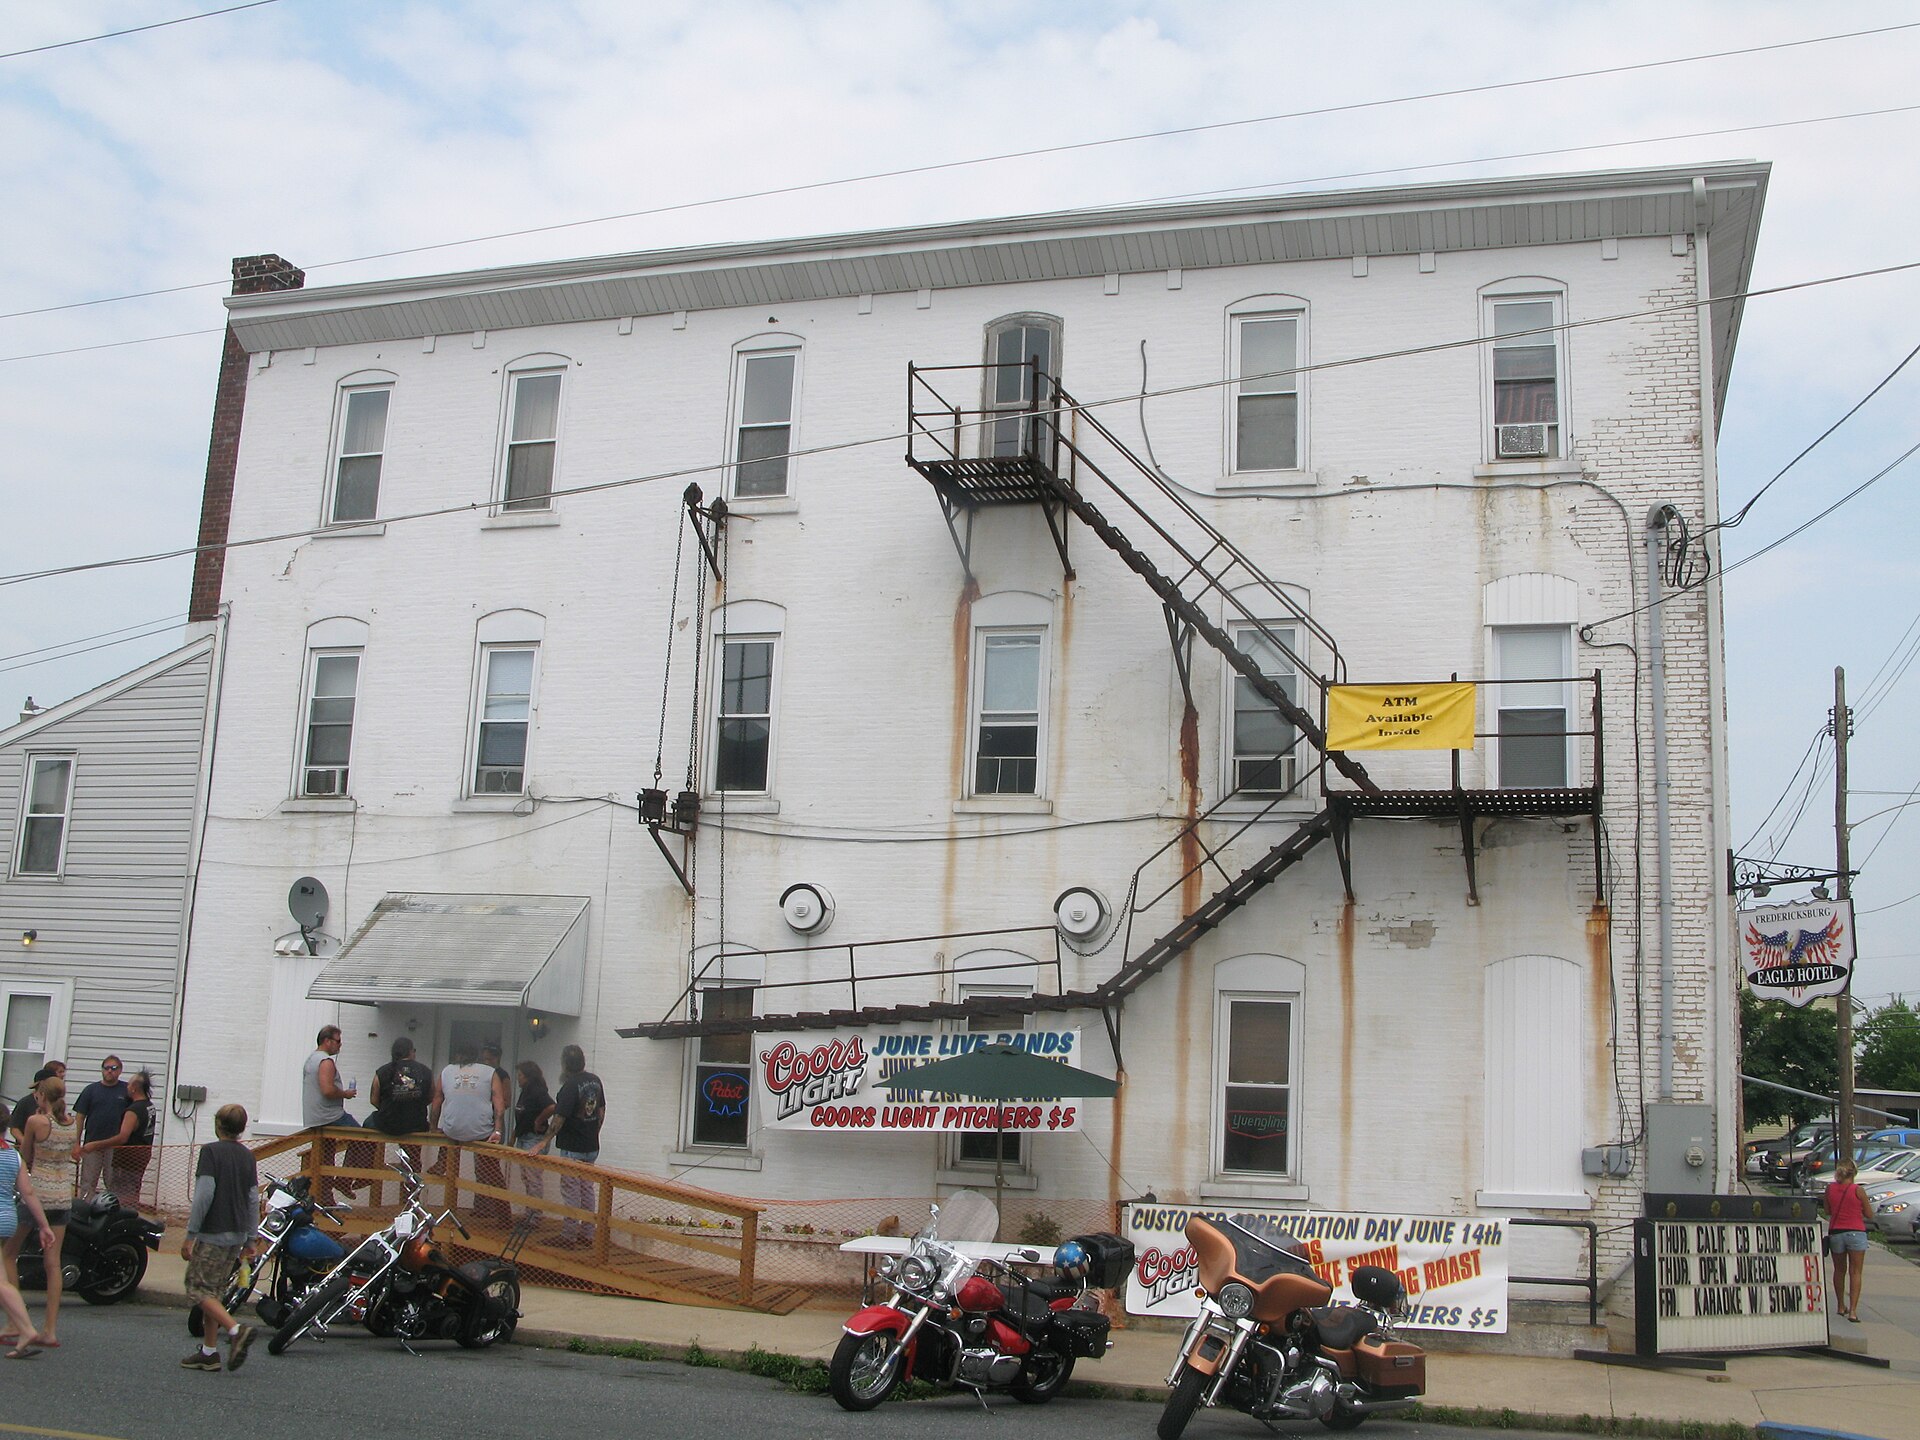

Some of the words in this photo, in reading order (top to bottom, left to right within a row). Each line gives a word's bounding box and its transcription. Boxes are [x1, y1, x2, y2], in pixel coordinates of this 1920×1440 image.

[1382, 697, 1418, 707] ATM
[1365, 713, 1433, 723] Available
[1378, 728, 1420, 737] Inside
[1755, 907, 1831, 924] FREDERICKSBURG
[1757, 970, 1795, 985] EAGLE
[1797, 965, 1838, 982] HOTEL
[871, 1035, 933, 1056] JUNE
[939, 1034, 989, 1055] LIVE
[760, 1035, 868, 1095] Coors
[709, 1079, 744, 1100] Pabst
[777, 1067, 867, 1121] LIGHT
[811, 1106, 876, 1127] COORS
[881, 1106, 940, 1128] LIGHT
[942, 1106, 1043, 1129] PITCHERS
[1047, 1106, 1076, 1130] $5
[1231, 1114, 1287, 1132] Yuengling
[1131, 1208, 1227, 1232] CUSTO
[1364, 1217, 1403, 1242] DAY
[1404, 1219, 1455, 1244] JUNE
[1462, 1222, 1503, 1246] 14th
[1658, 1225, 1690, 1254] THUR.
[1696, 1225, 1731, 1254] CALIF.
[1735, 1225, 1750, 1254] CB
[1756, 1225, 1781, 1253] CLUB
[1785, 1226, 1815, 1253] WRAP
[1136, 1243, 1199, 1289] Coor
[1312, 1260, 1343, 1288] IKE
[1393, 1266, 1419, 1295] OG
[1423, 1249, 1482, 1290] ROAST
[1658, 1256, 1691, 1285] THUR.
[1700, 1256, 1727, 1285] OPEN
[1734, 1255, 1778, 1284] JUKEBOX
[1147, 1268, 1200, 1307] LIGH
[1659, 1287, 1680, 1317] FRI.
[1694, 1286, 1742, 1316] KARAOKE
[1748, 1286, 1763, 1314] W/
[1769, 1285, 1802, 1313] STOMP
[1470, 1308, 1499, 1328] $5
